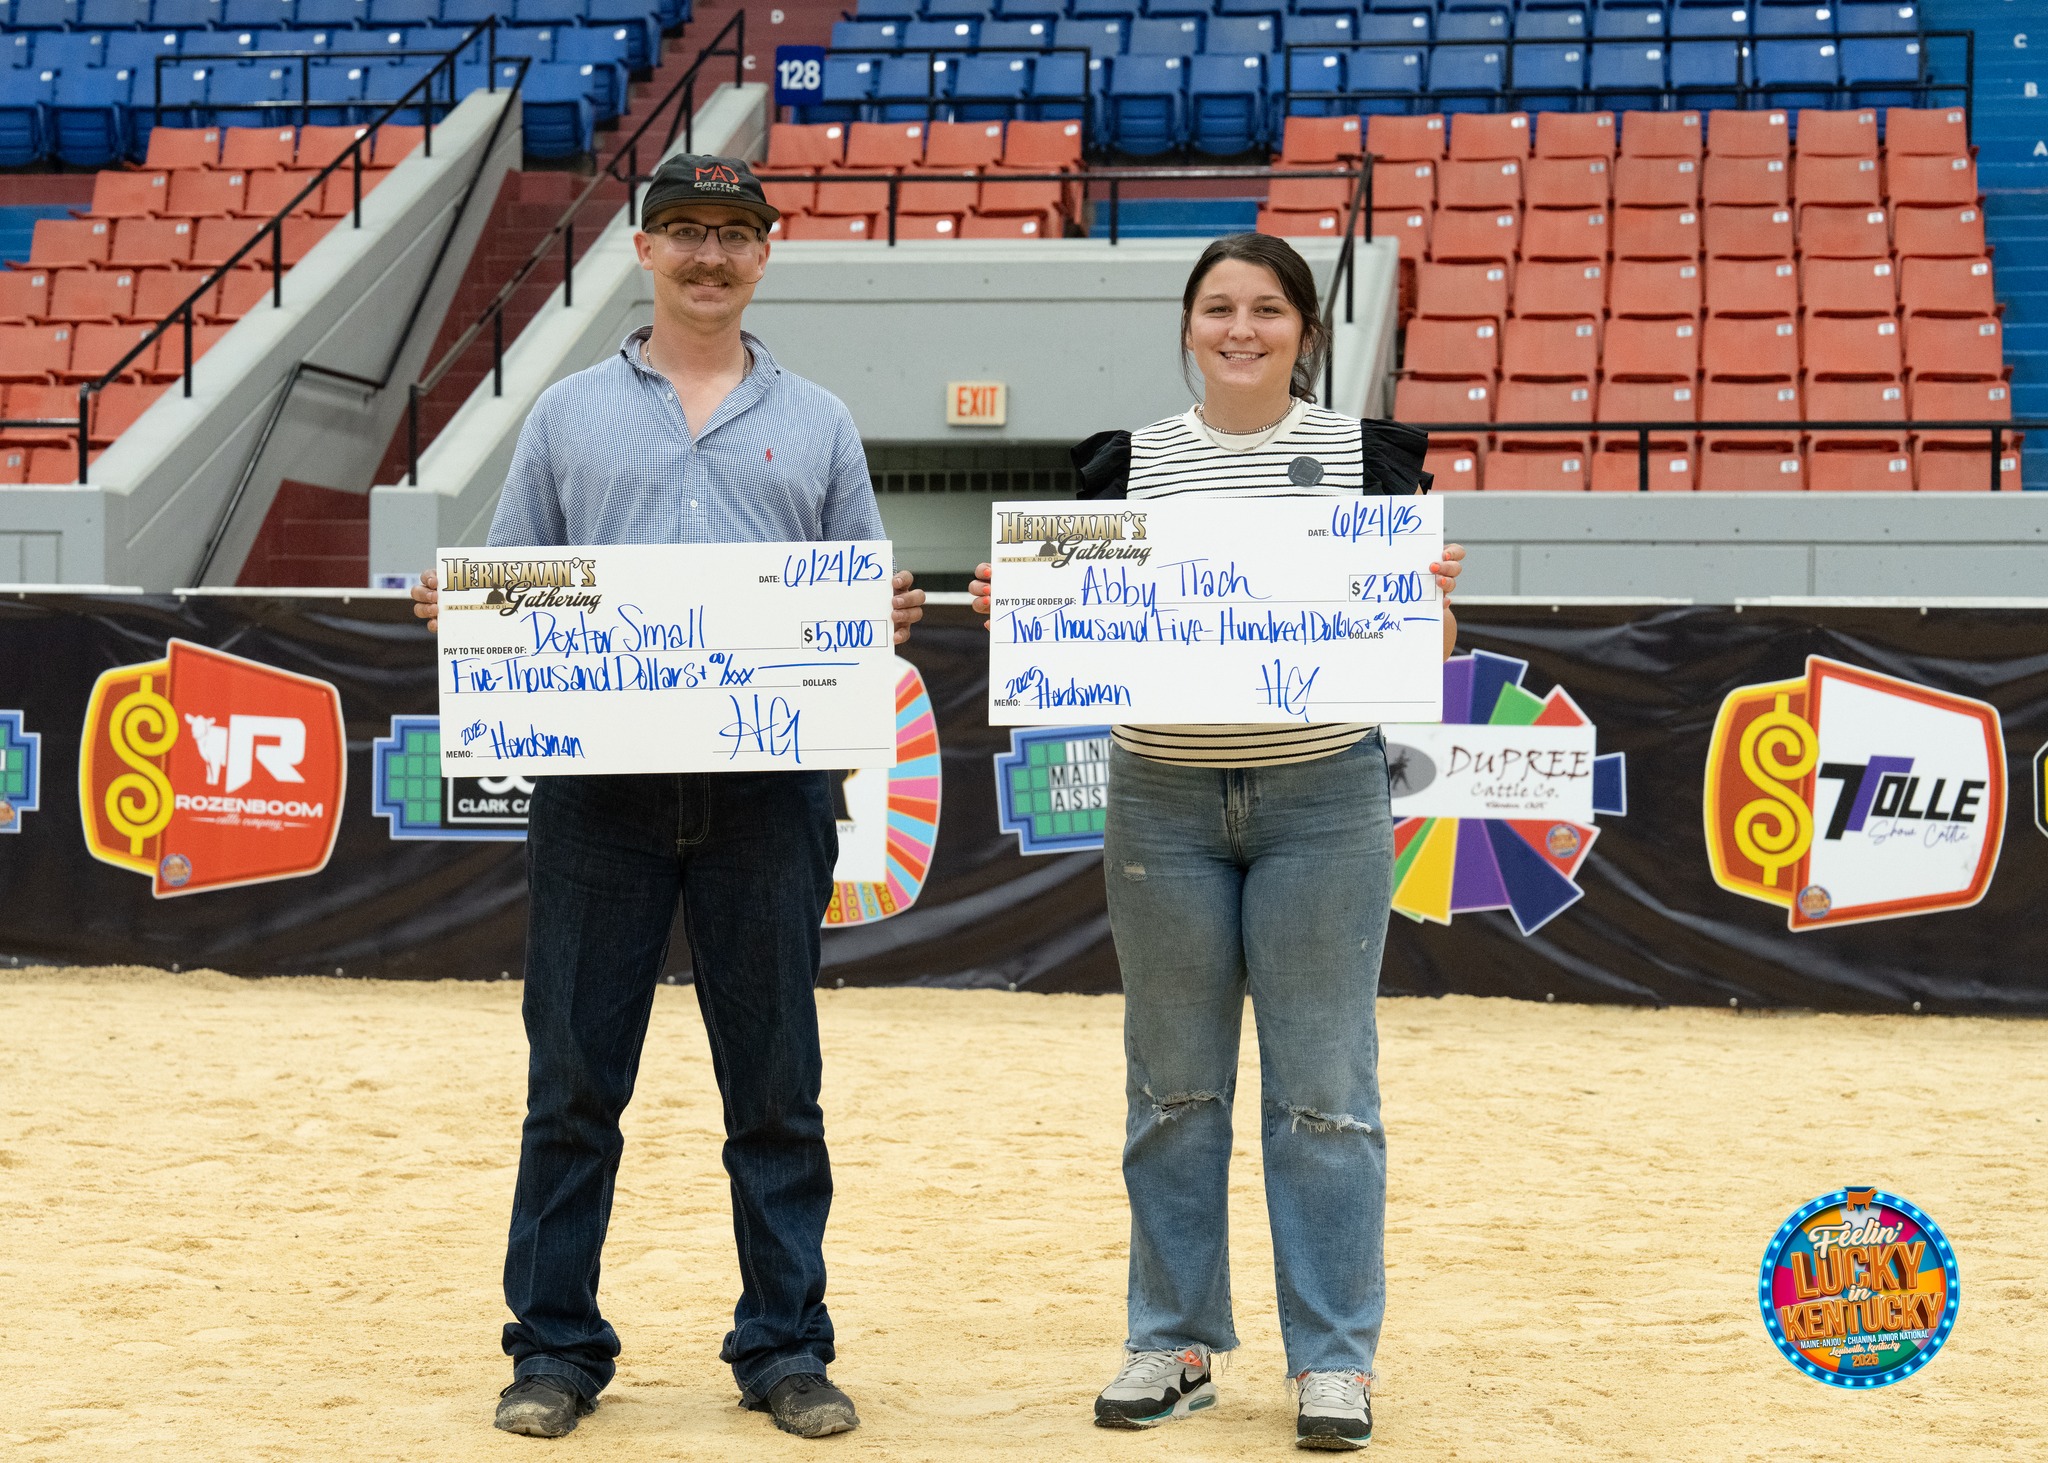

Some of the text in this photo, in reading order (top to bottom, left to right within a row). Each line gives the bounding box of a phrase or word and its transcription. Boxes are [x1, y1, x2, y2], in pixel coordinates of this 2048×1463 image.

[771, 9, 784, 24] D
[2013, 33, 2028, 49] C
[743, 55, 756, 70] C
[777, 59, 821, 91] 128
[2024, 82, 2038, 98] B
[2033, 140, 2048, 157] A
[694, 181, 741, 192] CATTLE
[957, 386, 998, 416] EXIT
[996, 511, 1148, 544] HERDSMAN'S
[1331, 497, 1422, 546] 6/24/25
[1307, 529, 1329, 537] DATE:
[1050, 533, 1152, 569] Gathering
[441, 557, 597, 592] HERDSMAN'S
[783, 545, 884, 588] 6/24/25
[758, 575, 780, 583] DATE:
[500, 580, 603, 617] Gathering
[995, 597, 1077, 606] PAY TO THE ORDER OF:
[1081, 565, 1156, 618] Abby
[520, 604, 705, 659] Dexter Small
[1350, 631, 1384, 639] DOLLARS
[443, 646, 527, 656] PAY TO THE ORDER OF:
[802, 678, 837, 687] DOLLARS
[994, 698, 1021, 707] MEMO:
[1031, 677, 1132, 710] Herdsman
[489, 720, 586, 760] Herdsman
[226, 714, 306, 793] R
[445, 750, 473, 758] MEMO:
[1471, 781, 1559, 798] Cattle Co.
[1818, 755, 1987, 840] TOLLE
[175, 794, 324, 818] ROZENBOOM
[457, 798, 509, 814] CLARK
[1868, 815, 1969, 849] Show Cattle
